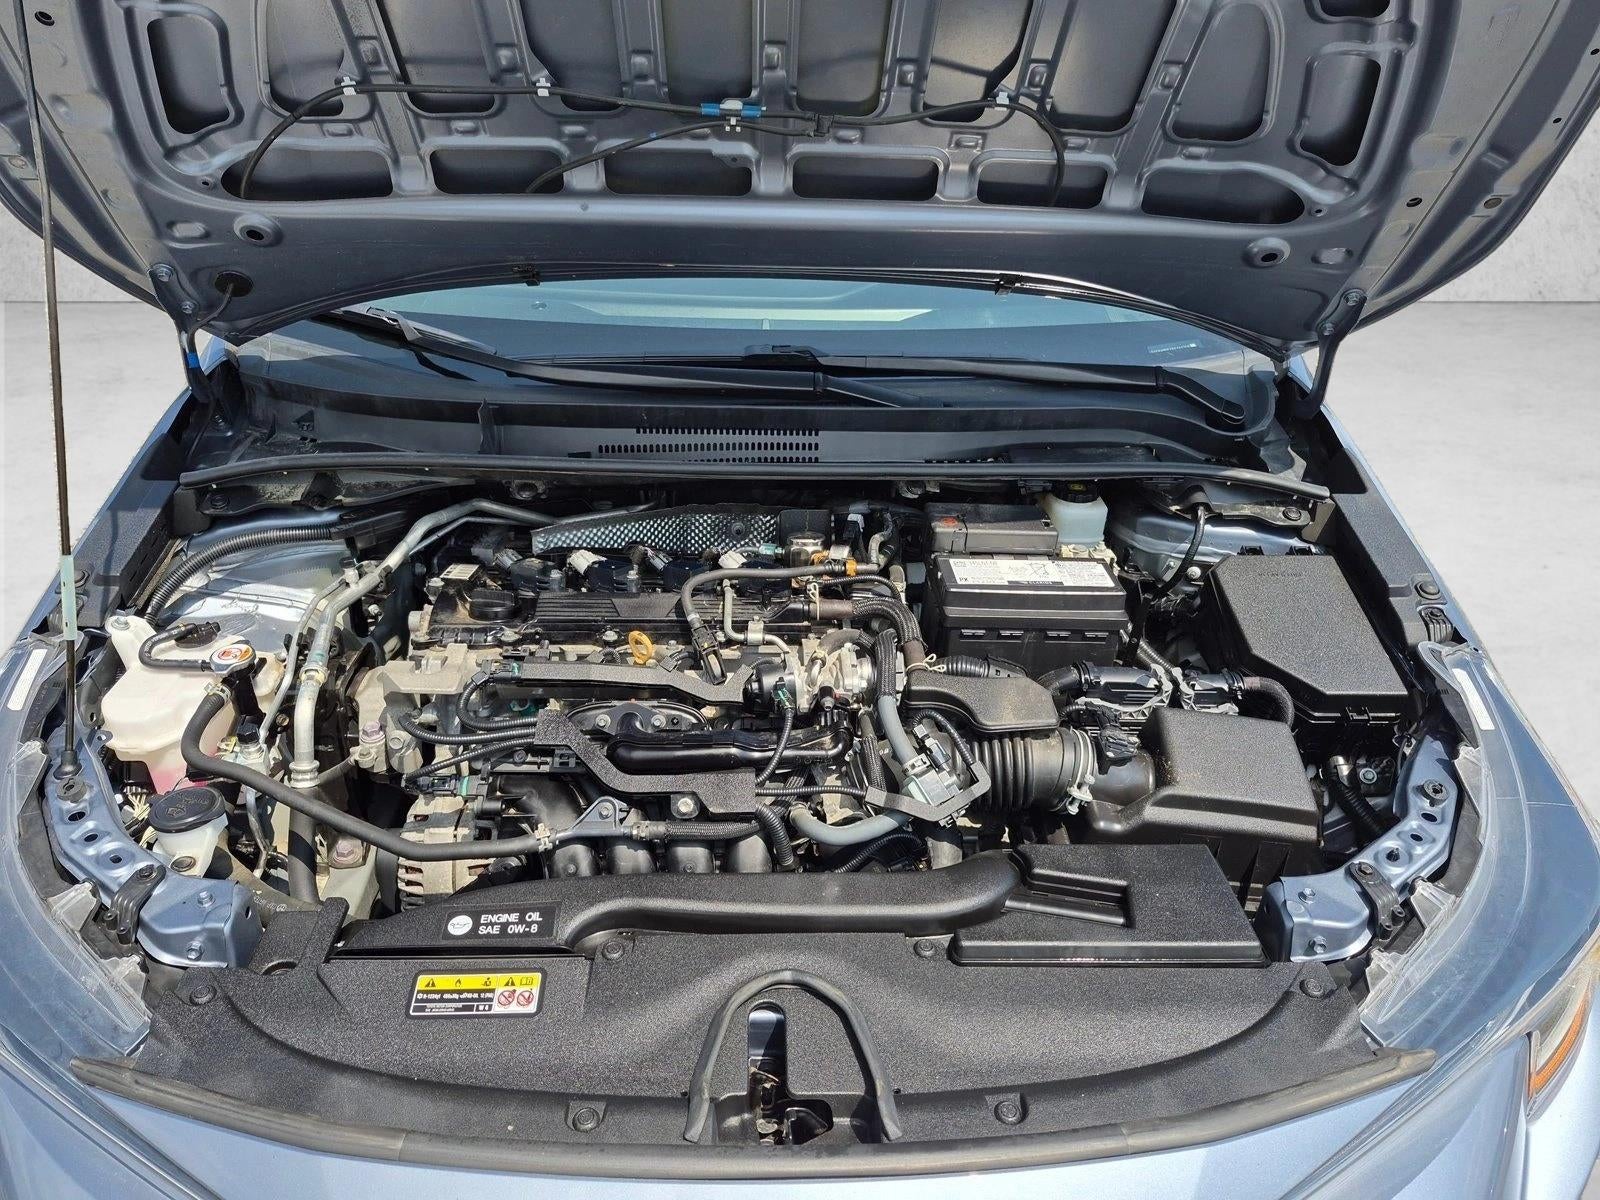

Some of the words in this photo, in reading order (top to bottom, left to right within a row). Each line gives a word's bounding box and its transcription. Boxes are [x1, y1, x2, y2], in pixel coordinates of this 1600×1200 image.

[480, 912, 520, 924] ENGINE
[525, 911, 543, 922] OIL
[478, 924, 501, 935] SAE
[507, 923, 538, 934] 0W-8
